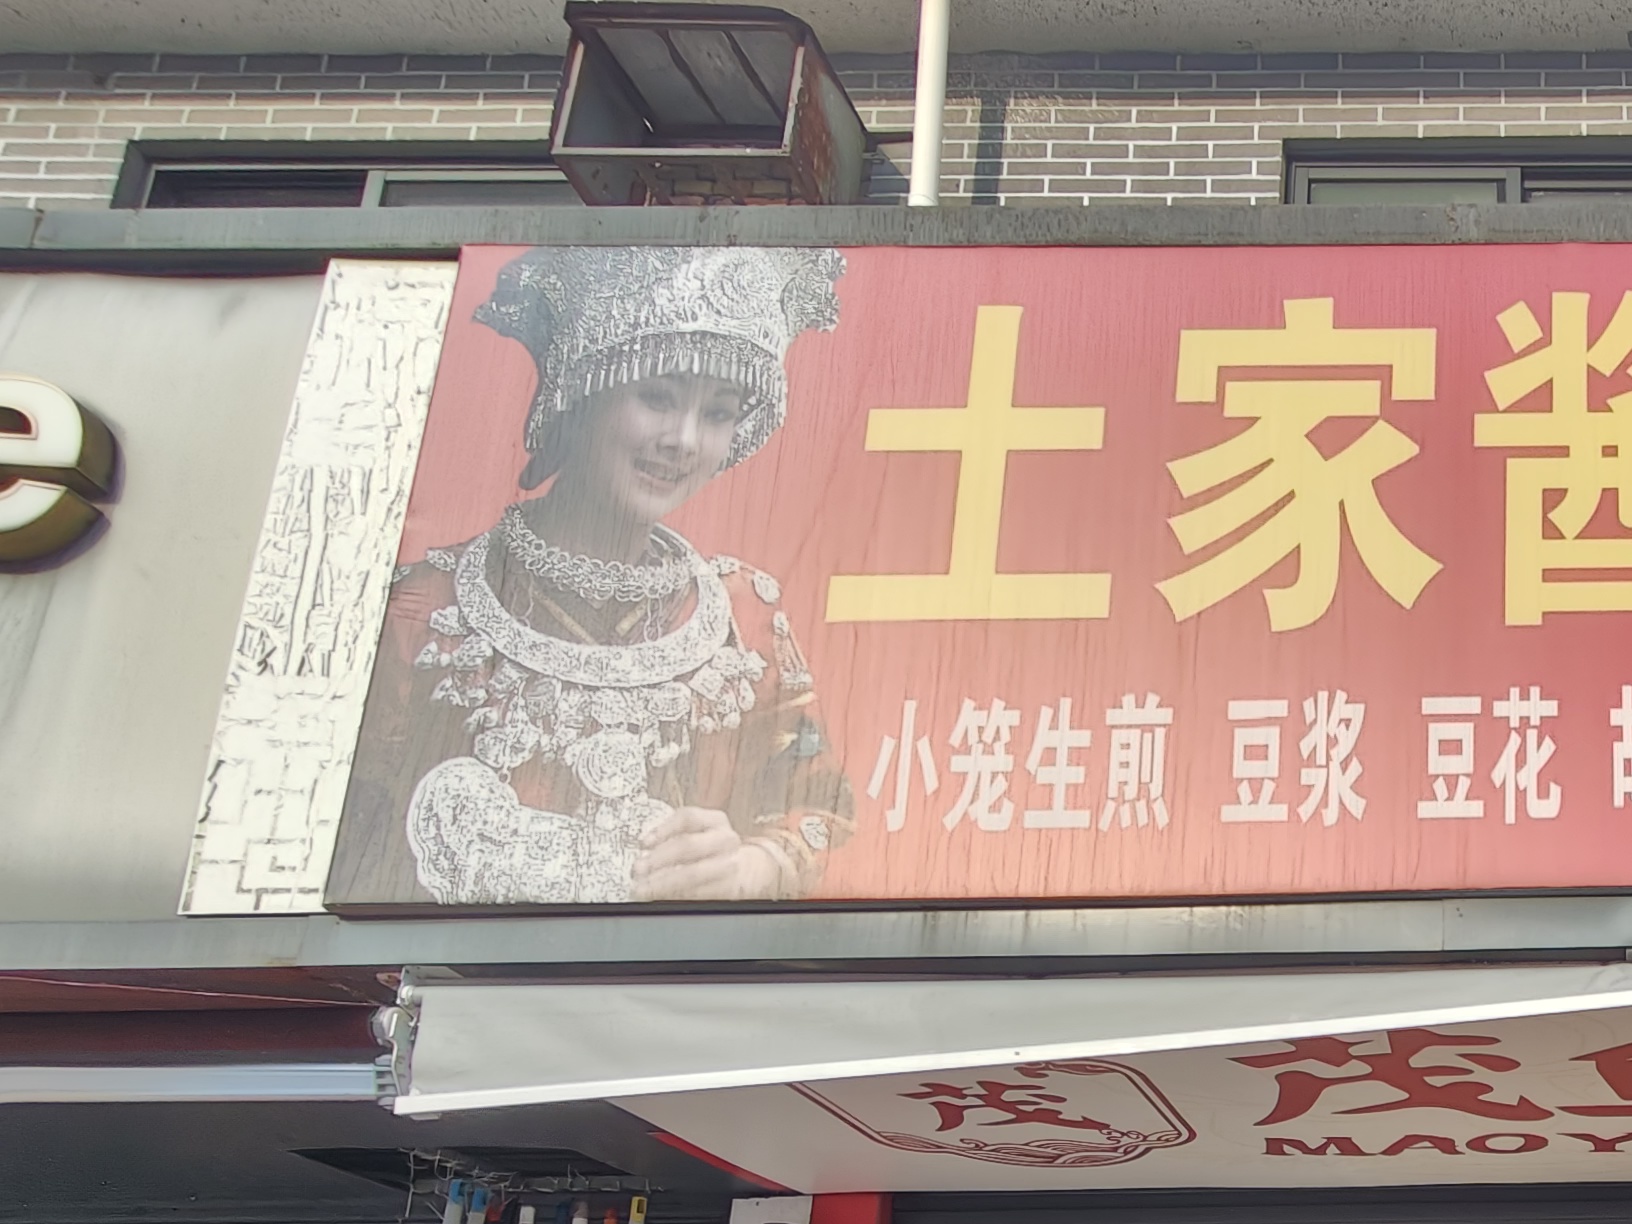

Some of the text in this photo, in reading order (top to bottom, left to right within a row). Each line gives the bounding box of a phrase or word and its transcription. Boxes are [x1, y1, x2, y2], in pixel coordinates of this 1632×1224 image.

[867, 692, 1174, 832] 小笼生煎
[1220, 689, 1366, 827] 豆浆
[1416, 685, 1562, 826] 豆花
